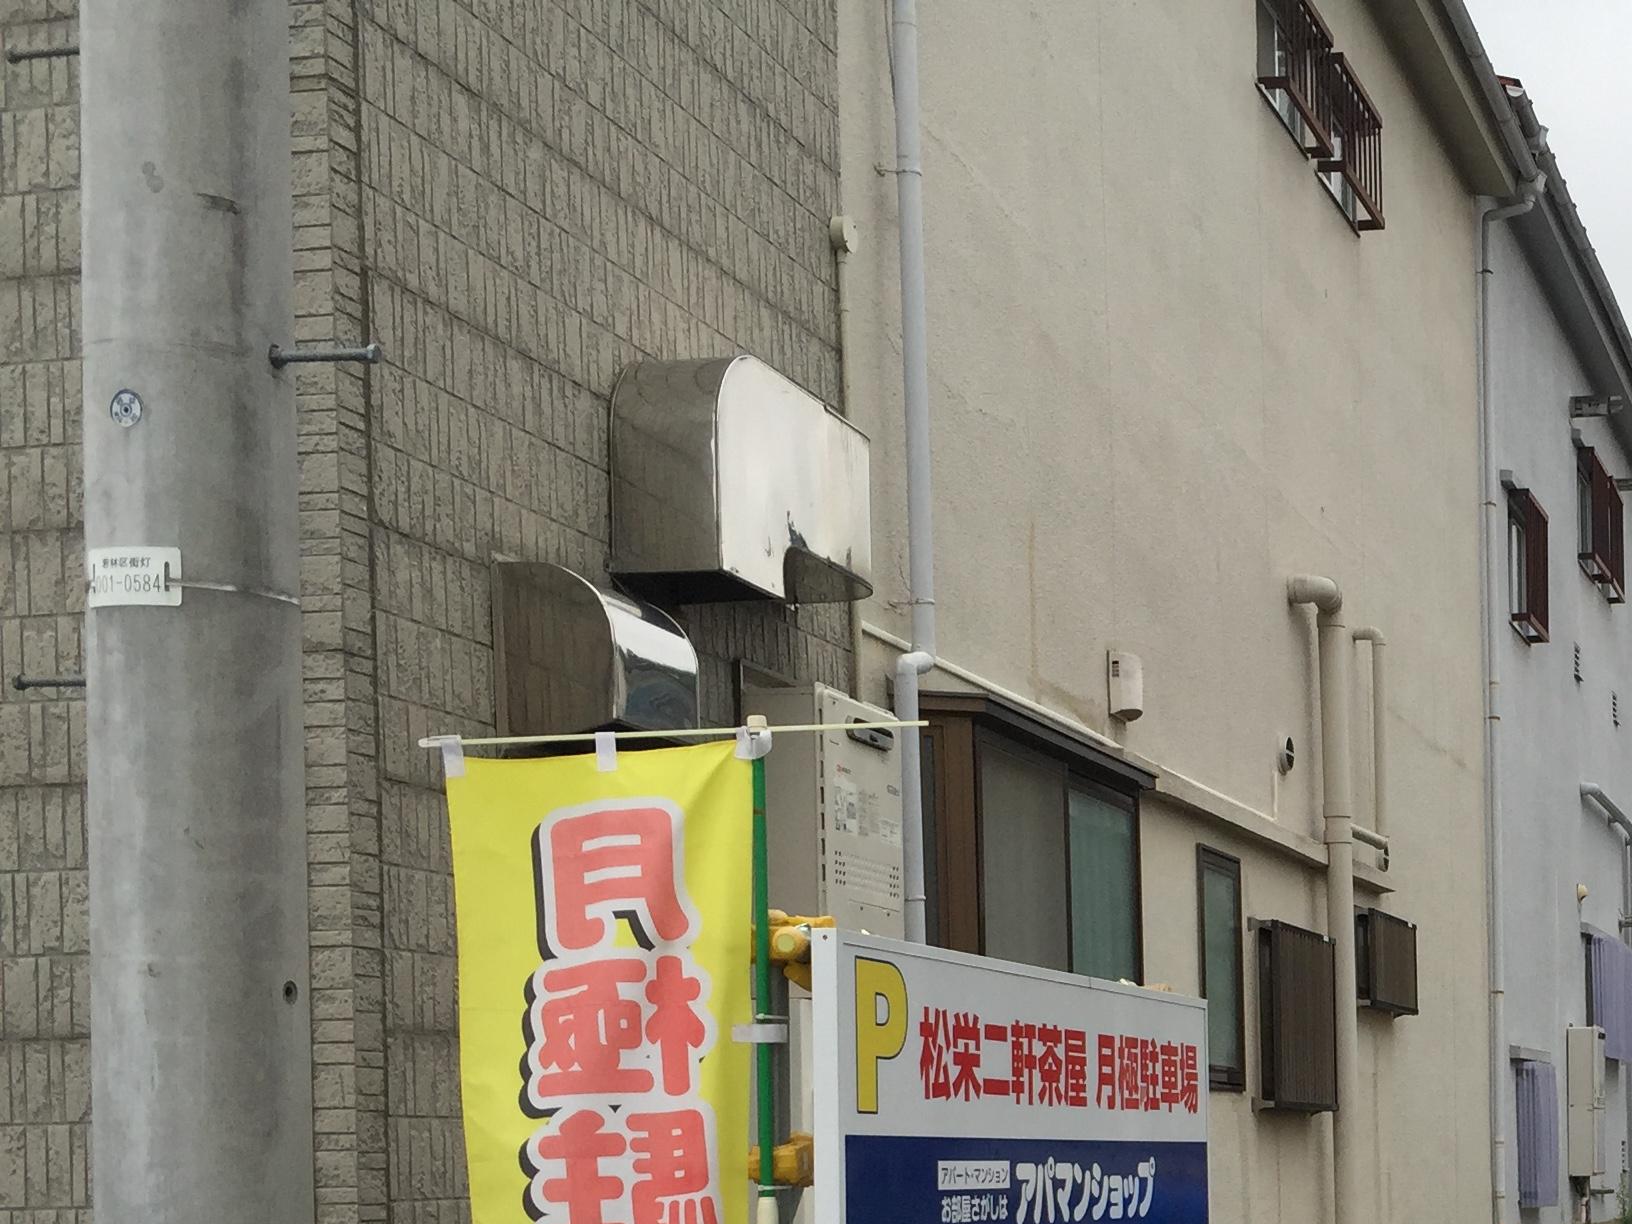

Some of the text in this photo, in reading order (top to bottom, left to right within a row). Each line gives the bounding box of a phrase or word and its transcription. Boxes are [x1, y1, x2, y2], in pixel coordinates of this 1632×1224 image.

[855, 955, 908, 1115] P
[919, 1006, 1199, 1115] 松栄二軒茶屋 月極駐車場
[941, 1166, 1009, 1185] アパート・マンション
[941, 1193, 1009, 1223] お部屋さがしは
